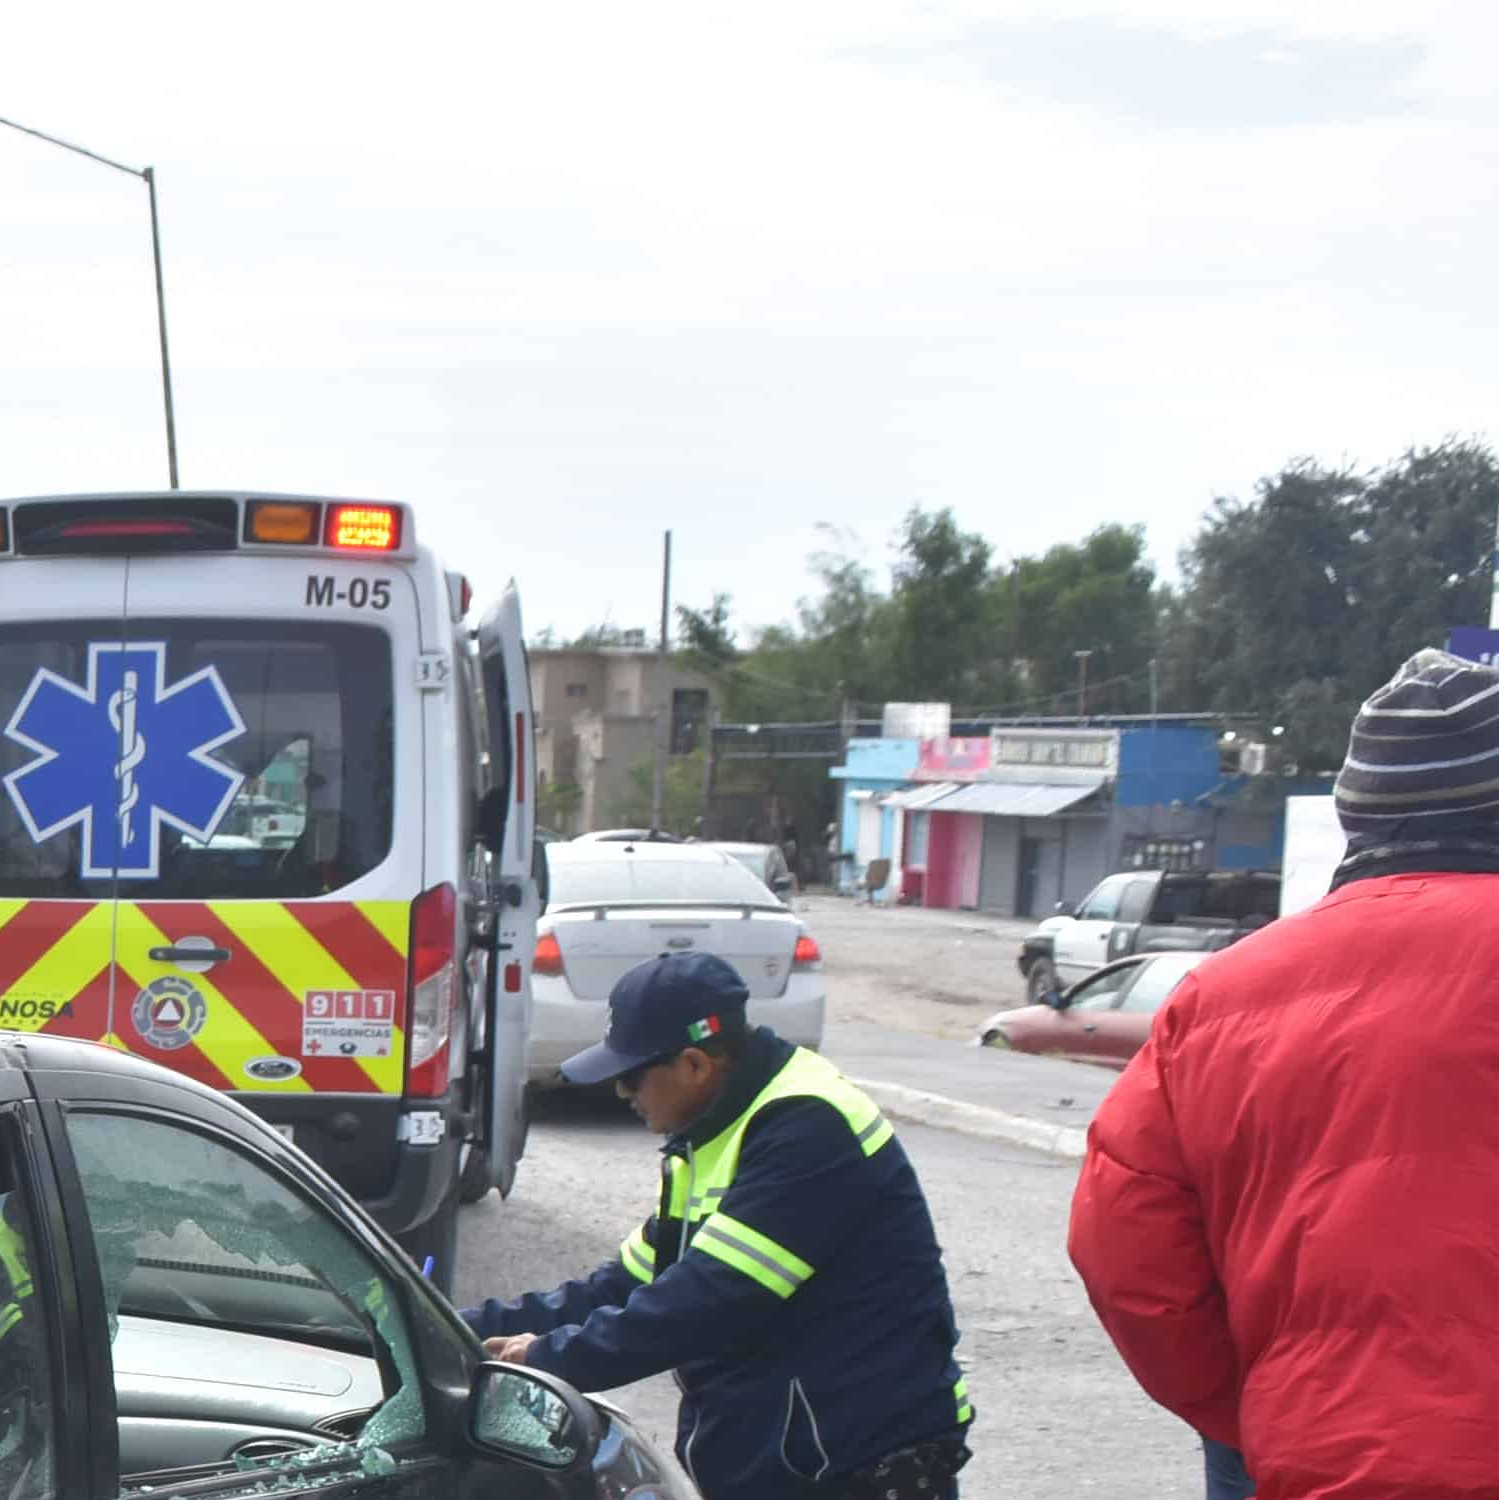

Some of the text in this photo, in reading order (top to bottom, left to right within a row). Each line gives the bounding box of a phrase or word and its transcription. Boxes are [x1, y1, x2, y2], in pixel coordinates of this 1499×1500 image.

[305, 575, 392, 609] M-05
[309, 994, 385, 1015] 911
[305, 1027, 391, 1039] EMERGENCIAS
